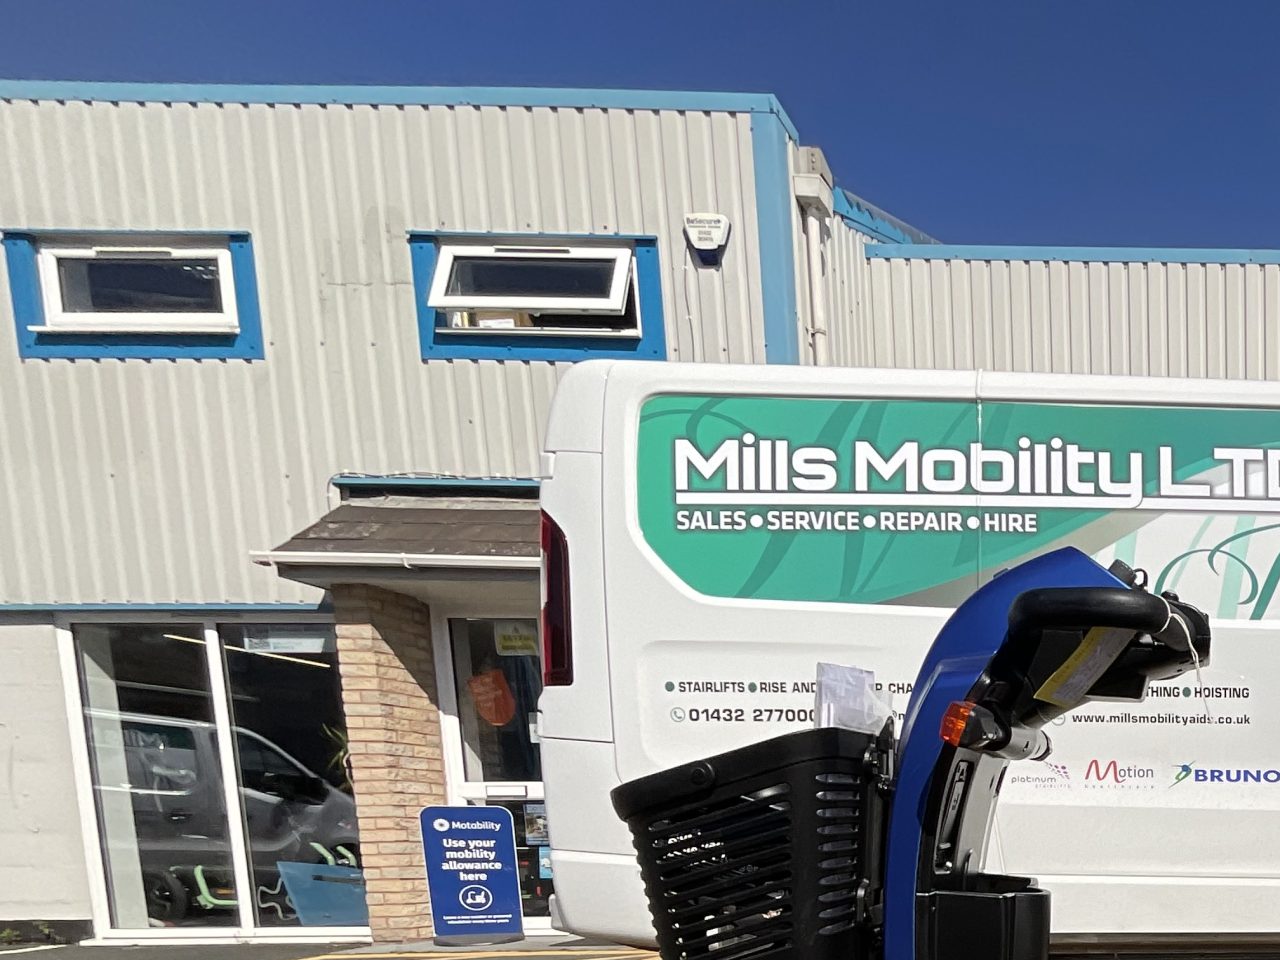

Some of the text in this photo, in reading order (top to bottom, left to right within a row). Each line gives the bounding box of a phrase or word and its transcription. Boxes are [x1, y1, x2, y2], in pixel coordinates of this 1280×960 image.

[674, 432, 838, 492] Mills
[855, 436, 1143, 508] Mobility
[676, 510, 1038, 533] SALES SERVICE REPAIR HIRE
[678, 681, 746, 693] STAIRLIFTS
[759, 682, 788, 693] RISE
[888, 683, 913, 694] CHA
[1145, 686, 1250, 698] THING HOISTING
[688, 708, 745, 722] 01432
[1072, 712, 1251, 726] www.millsmobilityaids.co.uk
[1084, 759, 1154, 783] Motion
[451, 820, 502, 832] Motability
[442, 838, 497, 850] Use your
[445, 848, 496, 861] mobility
[441, 860, 503, 870] allowance
[459, 871, 488, 881] here
